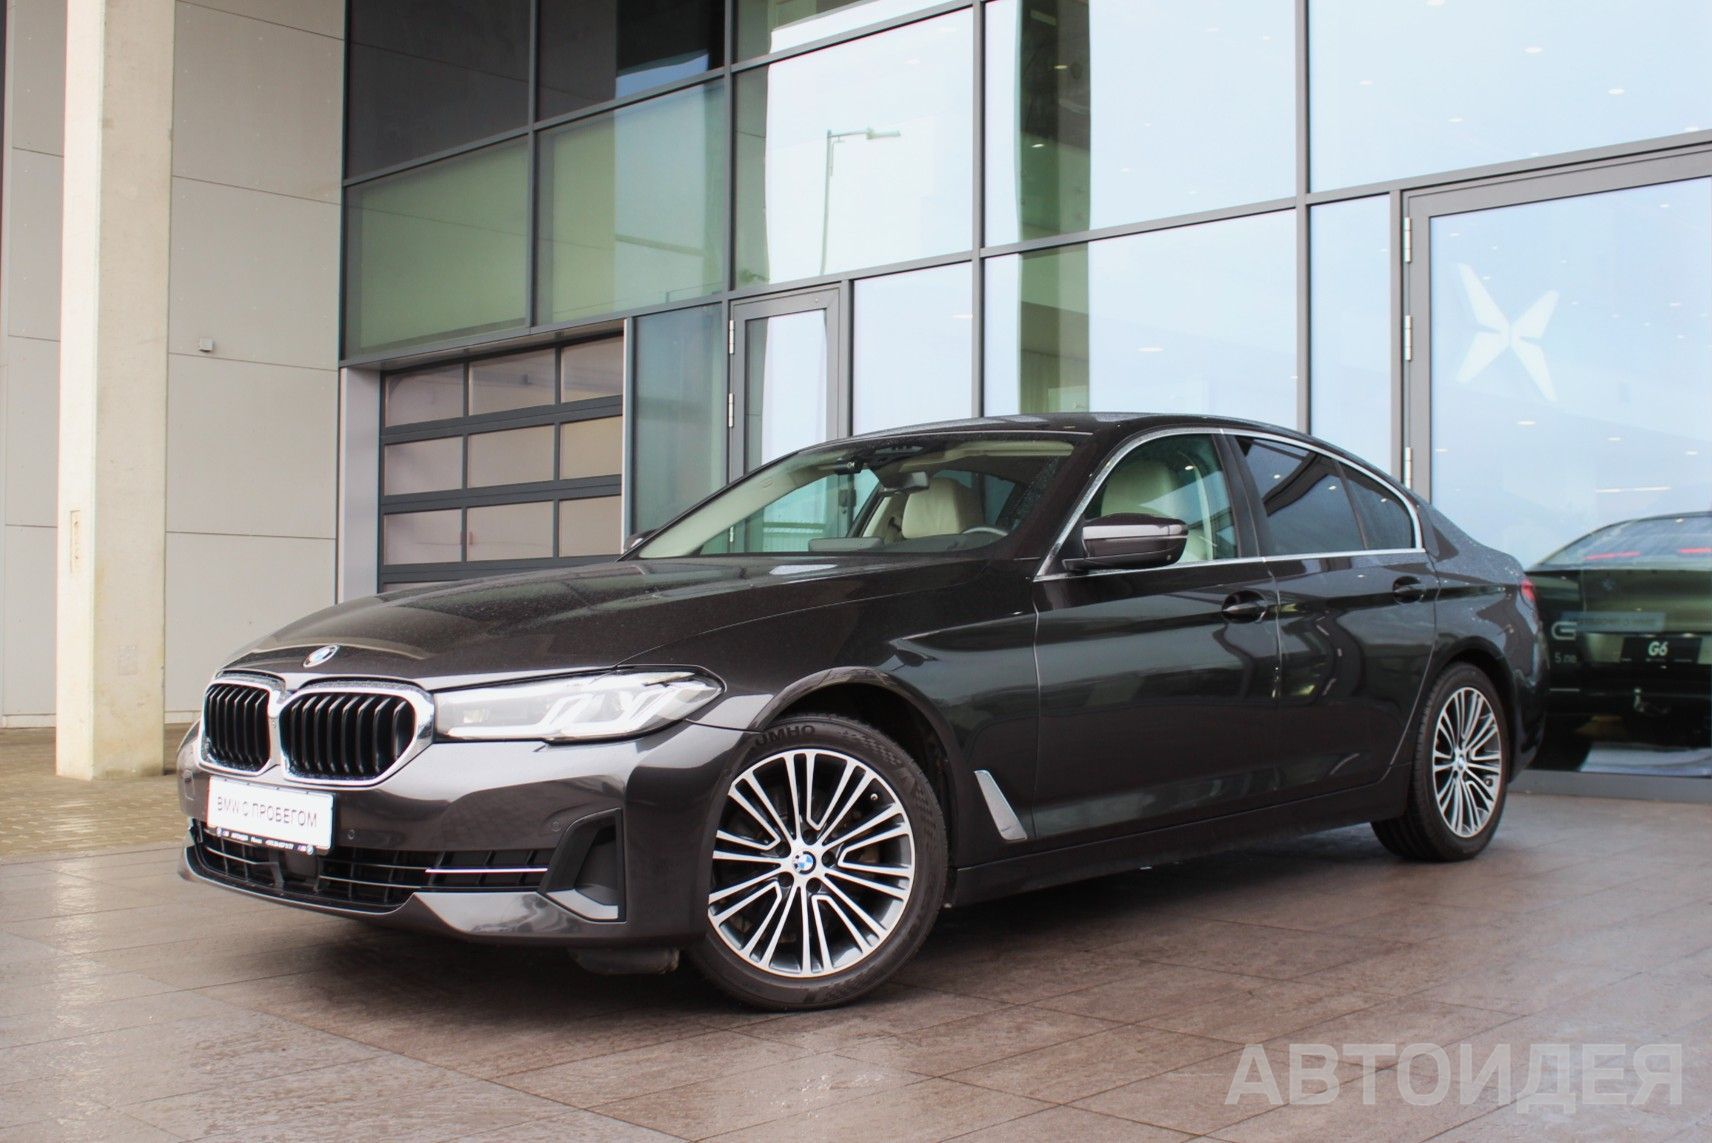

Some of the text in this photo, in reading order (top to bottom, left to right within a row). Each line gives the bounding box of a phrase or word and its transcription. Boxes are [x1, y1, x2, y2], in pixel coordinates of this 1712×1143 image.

[1648, 641, 1668, 656] G6
[752, 725, 815, 749] UMHO
[217, 796, 240, 814] BMW
[252, 802, 317, 828] ПРОБЕГОМ
